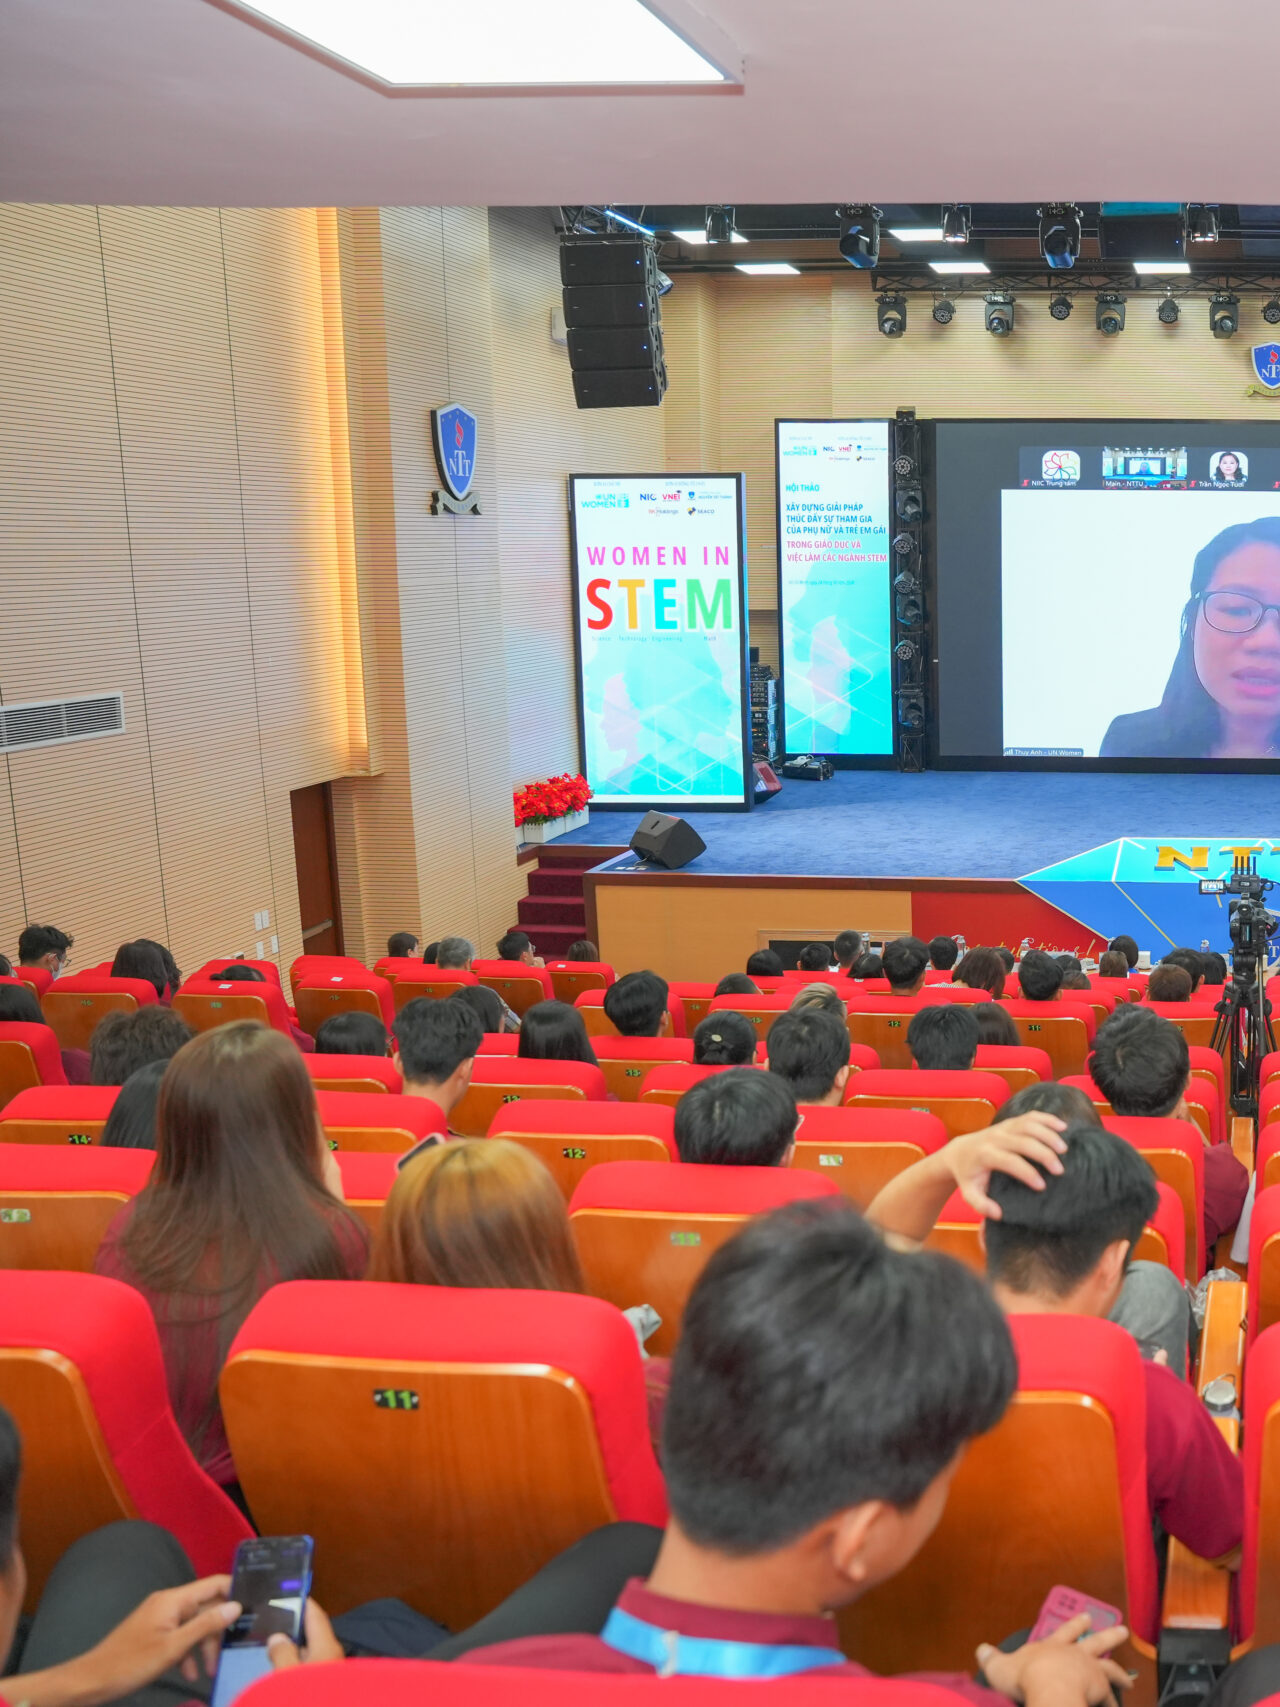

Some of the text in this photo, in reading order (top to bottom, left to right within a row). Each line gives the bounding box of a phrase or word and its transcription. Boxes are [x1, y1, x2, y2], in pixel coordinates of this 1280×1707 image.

[449, 450, 471, 477] NTT
[785, 482, 820, 493] HỘI THẢO
[1047, 480, 1063, 488] Trung
[640, 493, 657, 501] NIC
[786, 501, 863, 514] XÂY DỰNG GIẢI PHÁP
[786, 513, 805, 523] THÚC
[836, 515, 858, 523] THAM
[859, 515, 873, 523] GIA
[786, 524, 801, 534] CỦA
[803, 526, 819, 537] PHỤ
[834, 524, 844, 534] VÀ
[860, 526, 871, 534] EM
[873, 524, 886, 534] GÁI
[787, 538, 861, 551] TRONG GIÁO DỤC VÀ
[587, 546, 729, 566] WOMEN IN
[804, 551, 821, 561] LÀM
[822, 551, 837, 561] CÁC
[838, 551, 866, 562] NGÀNH
[867, 554, 887, 562] STEM
[586, 578, 732, 630] STEM
[72, 1135, 89, 1145] 14
[567, 1148, 583, 1159] 12
[383, 1389, 412, 1410] 11
